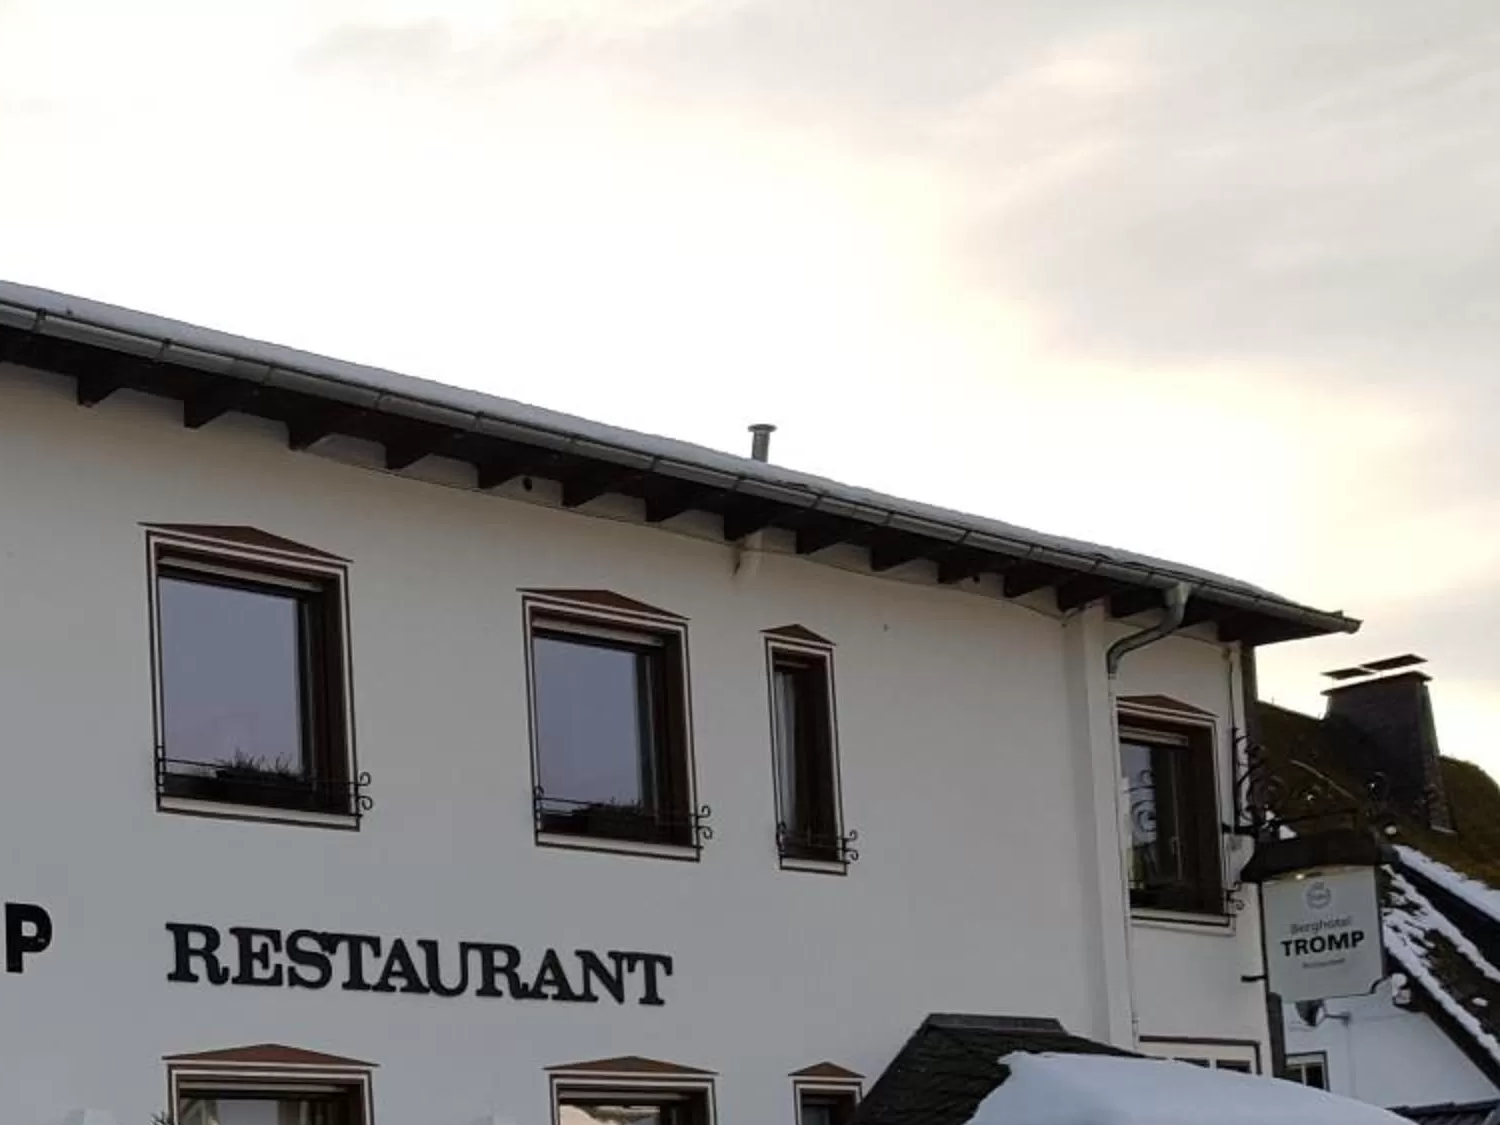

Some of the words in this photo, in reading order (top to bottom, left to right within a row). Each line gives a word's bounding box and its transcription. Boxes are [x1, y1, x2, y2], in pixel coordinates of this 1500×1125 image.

[1290, 916, 1353, 934] Berghotel
[1281, 930, 1365, 957] TROMP
[165, 922, 673, 1006] RESTAURANT
